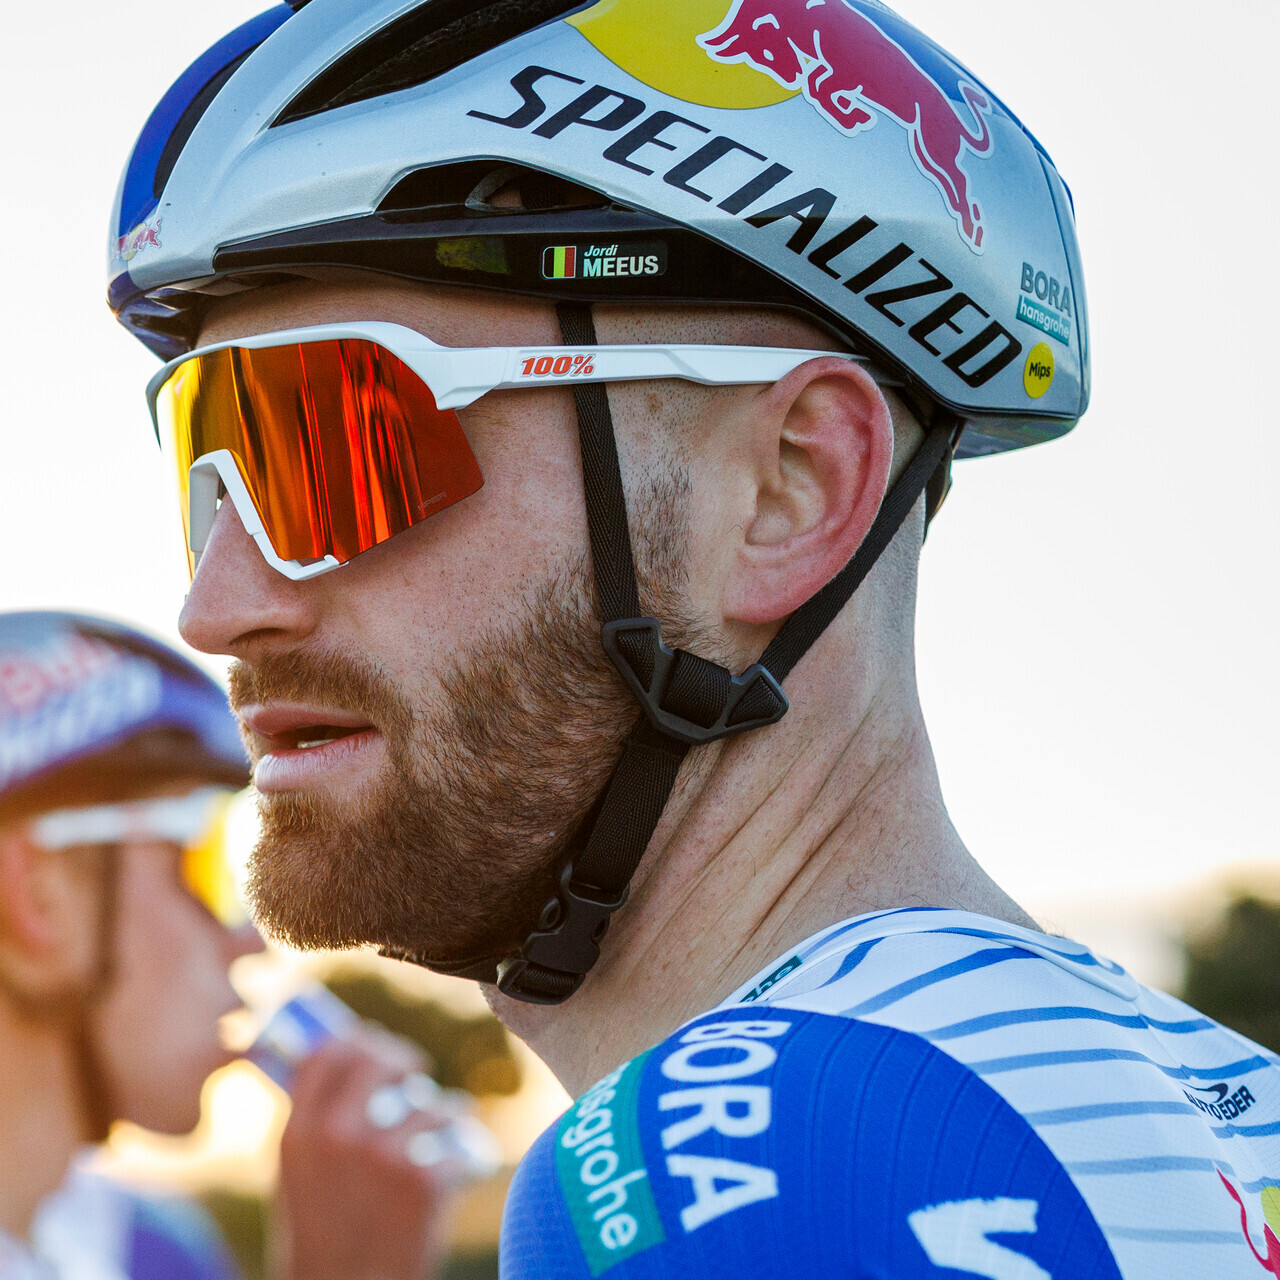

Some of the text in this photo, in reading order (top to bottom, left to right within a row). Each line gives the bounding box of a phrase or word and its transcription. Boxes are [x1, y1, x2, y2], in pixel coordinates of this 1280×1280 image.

[467, 65, 1023, 389] SPECIALIZED
[584, 244, 618, 257] Jordi
[583, 255, 659, 277] MEEUS
[1020, 261, 1072, 318] BORA
[1019, 302, 1070, 339] hansgrohe
[522, 355, 595, 376] 100%
[1028, 361, 1051, 380] Mips
[658, 1020, 792, 1233] BORA
